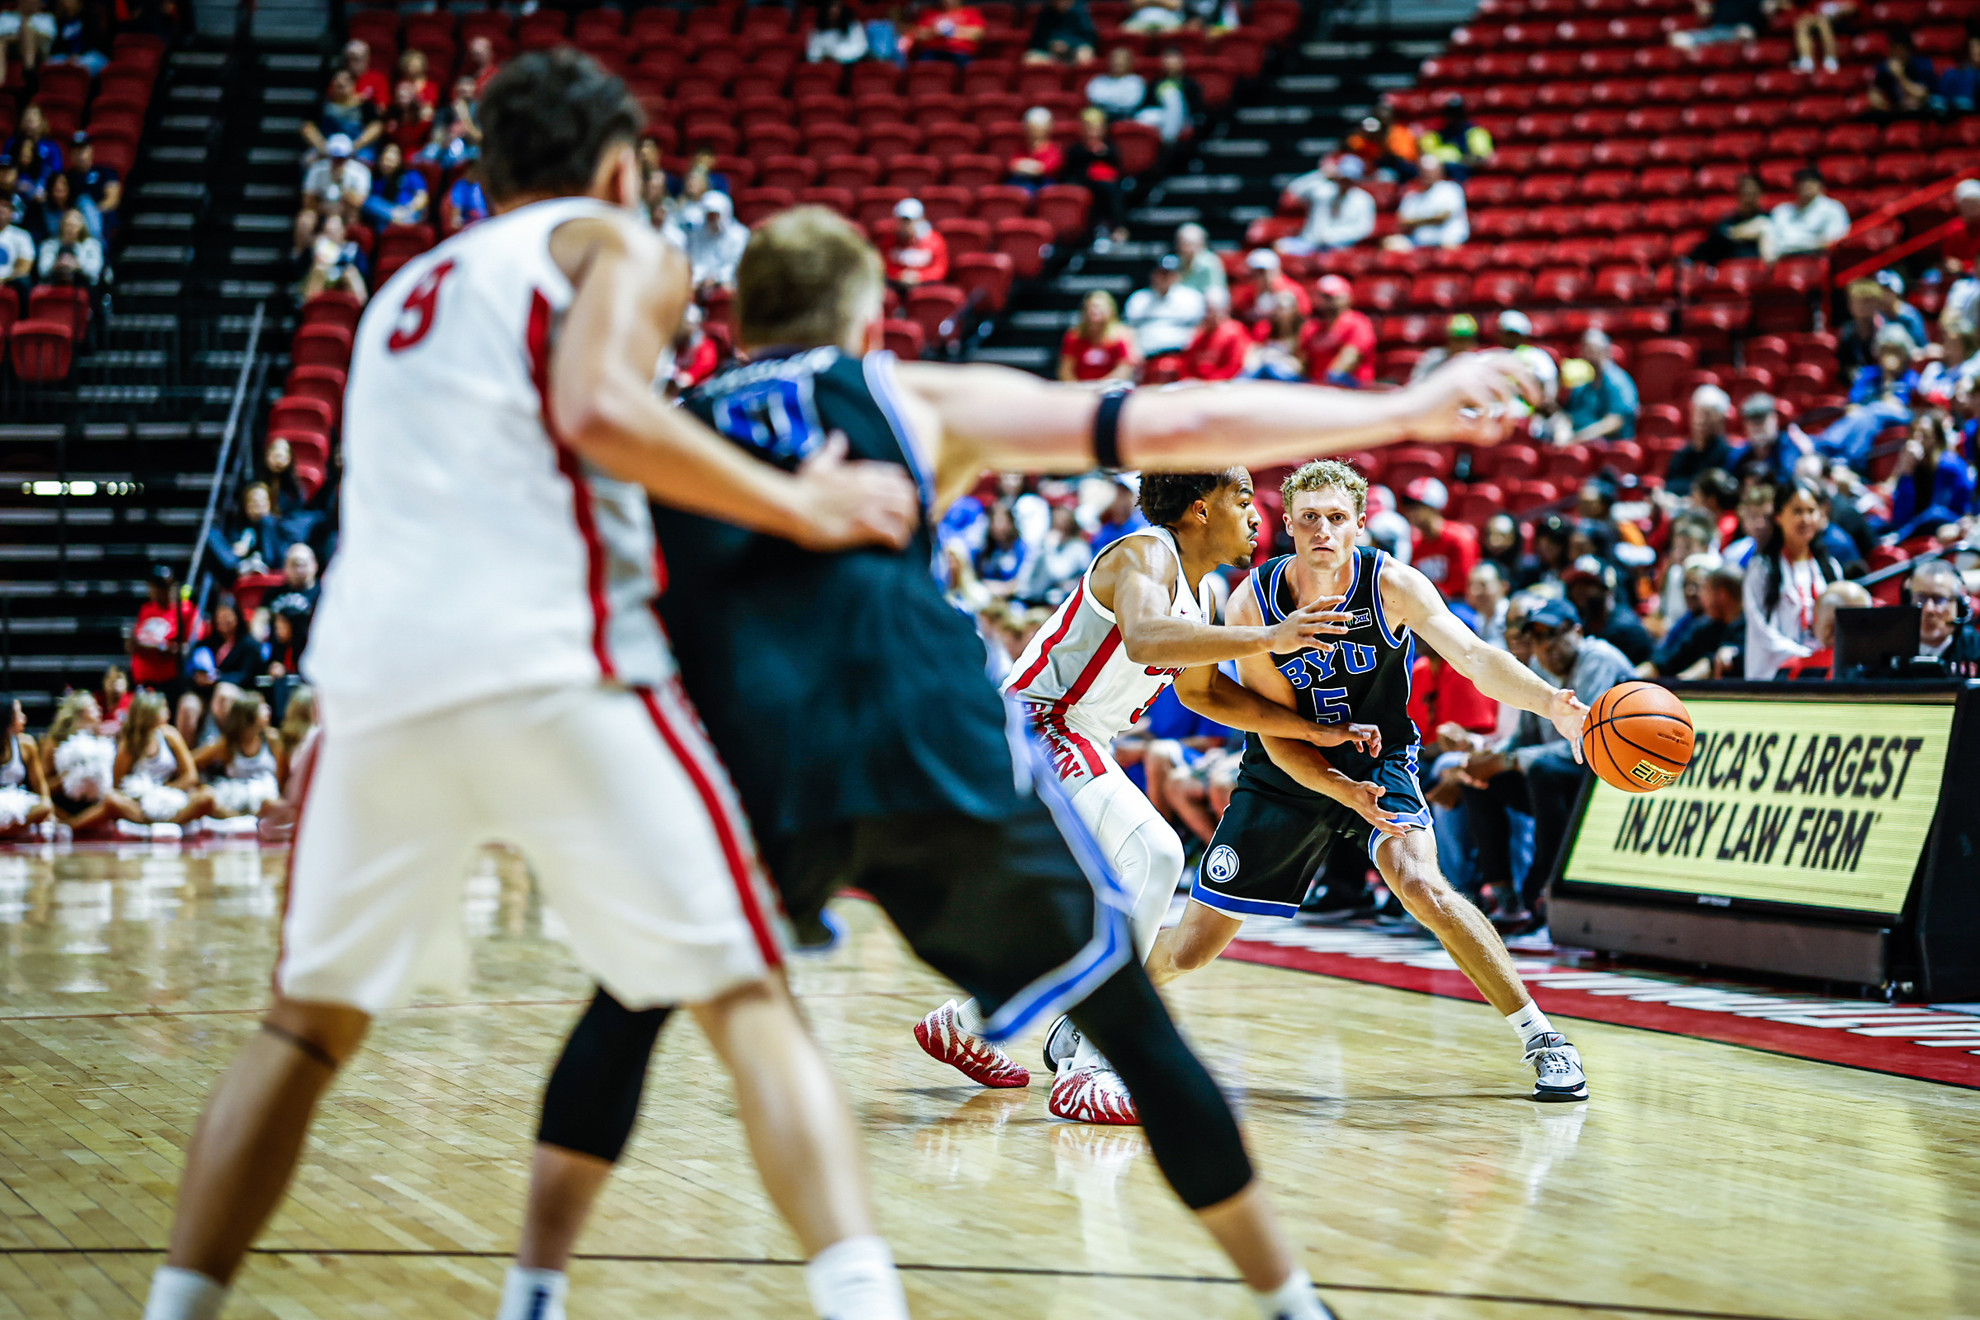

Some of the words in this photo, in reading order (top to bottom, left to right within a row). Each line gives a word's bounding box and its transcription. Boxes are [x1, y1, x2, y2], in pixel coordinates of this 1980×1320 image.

[1278, 640, 1377, 689] BYU
[1311, 687, 1352, 725] 5
[1630, 762, 1679, 787] ELITE
[1670, 731, 1778, 791] RICA'S
[1773, 734, 1924, 800] LARGEST
[1614, 797, 1725, 858] INJURY
[1716, 803, 1792, 865] LAW
